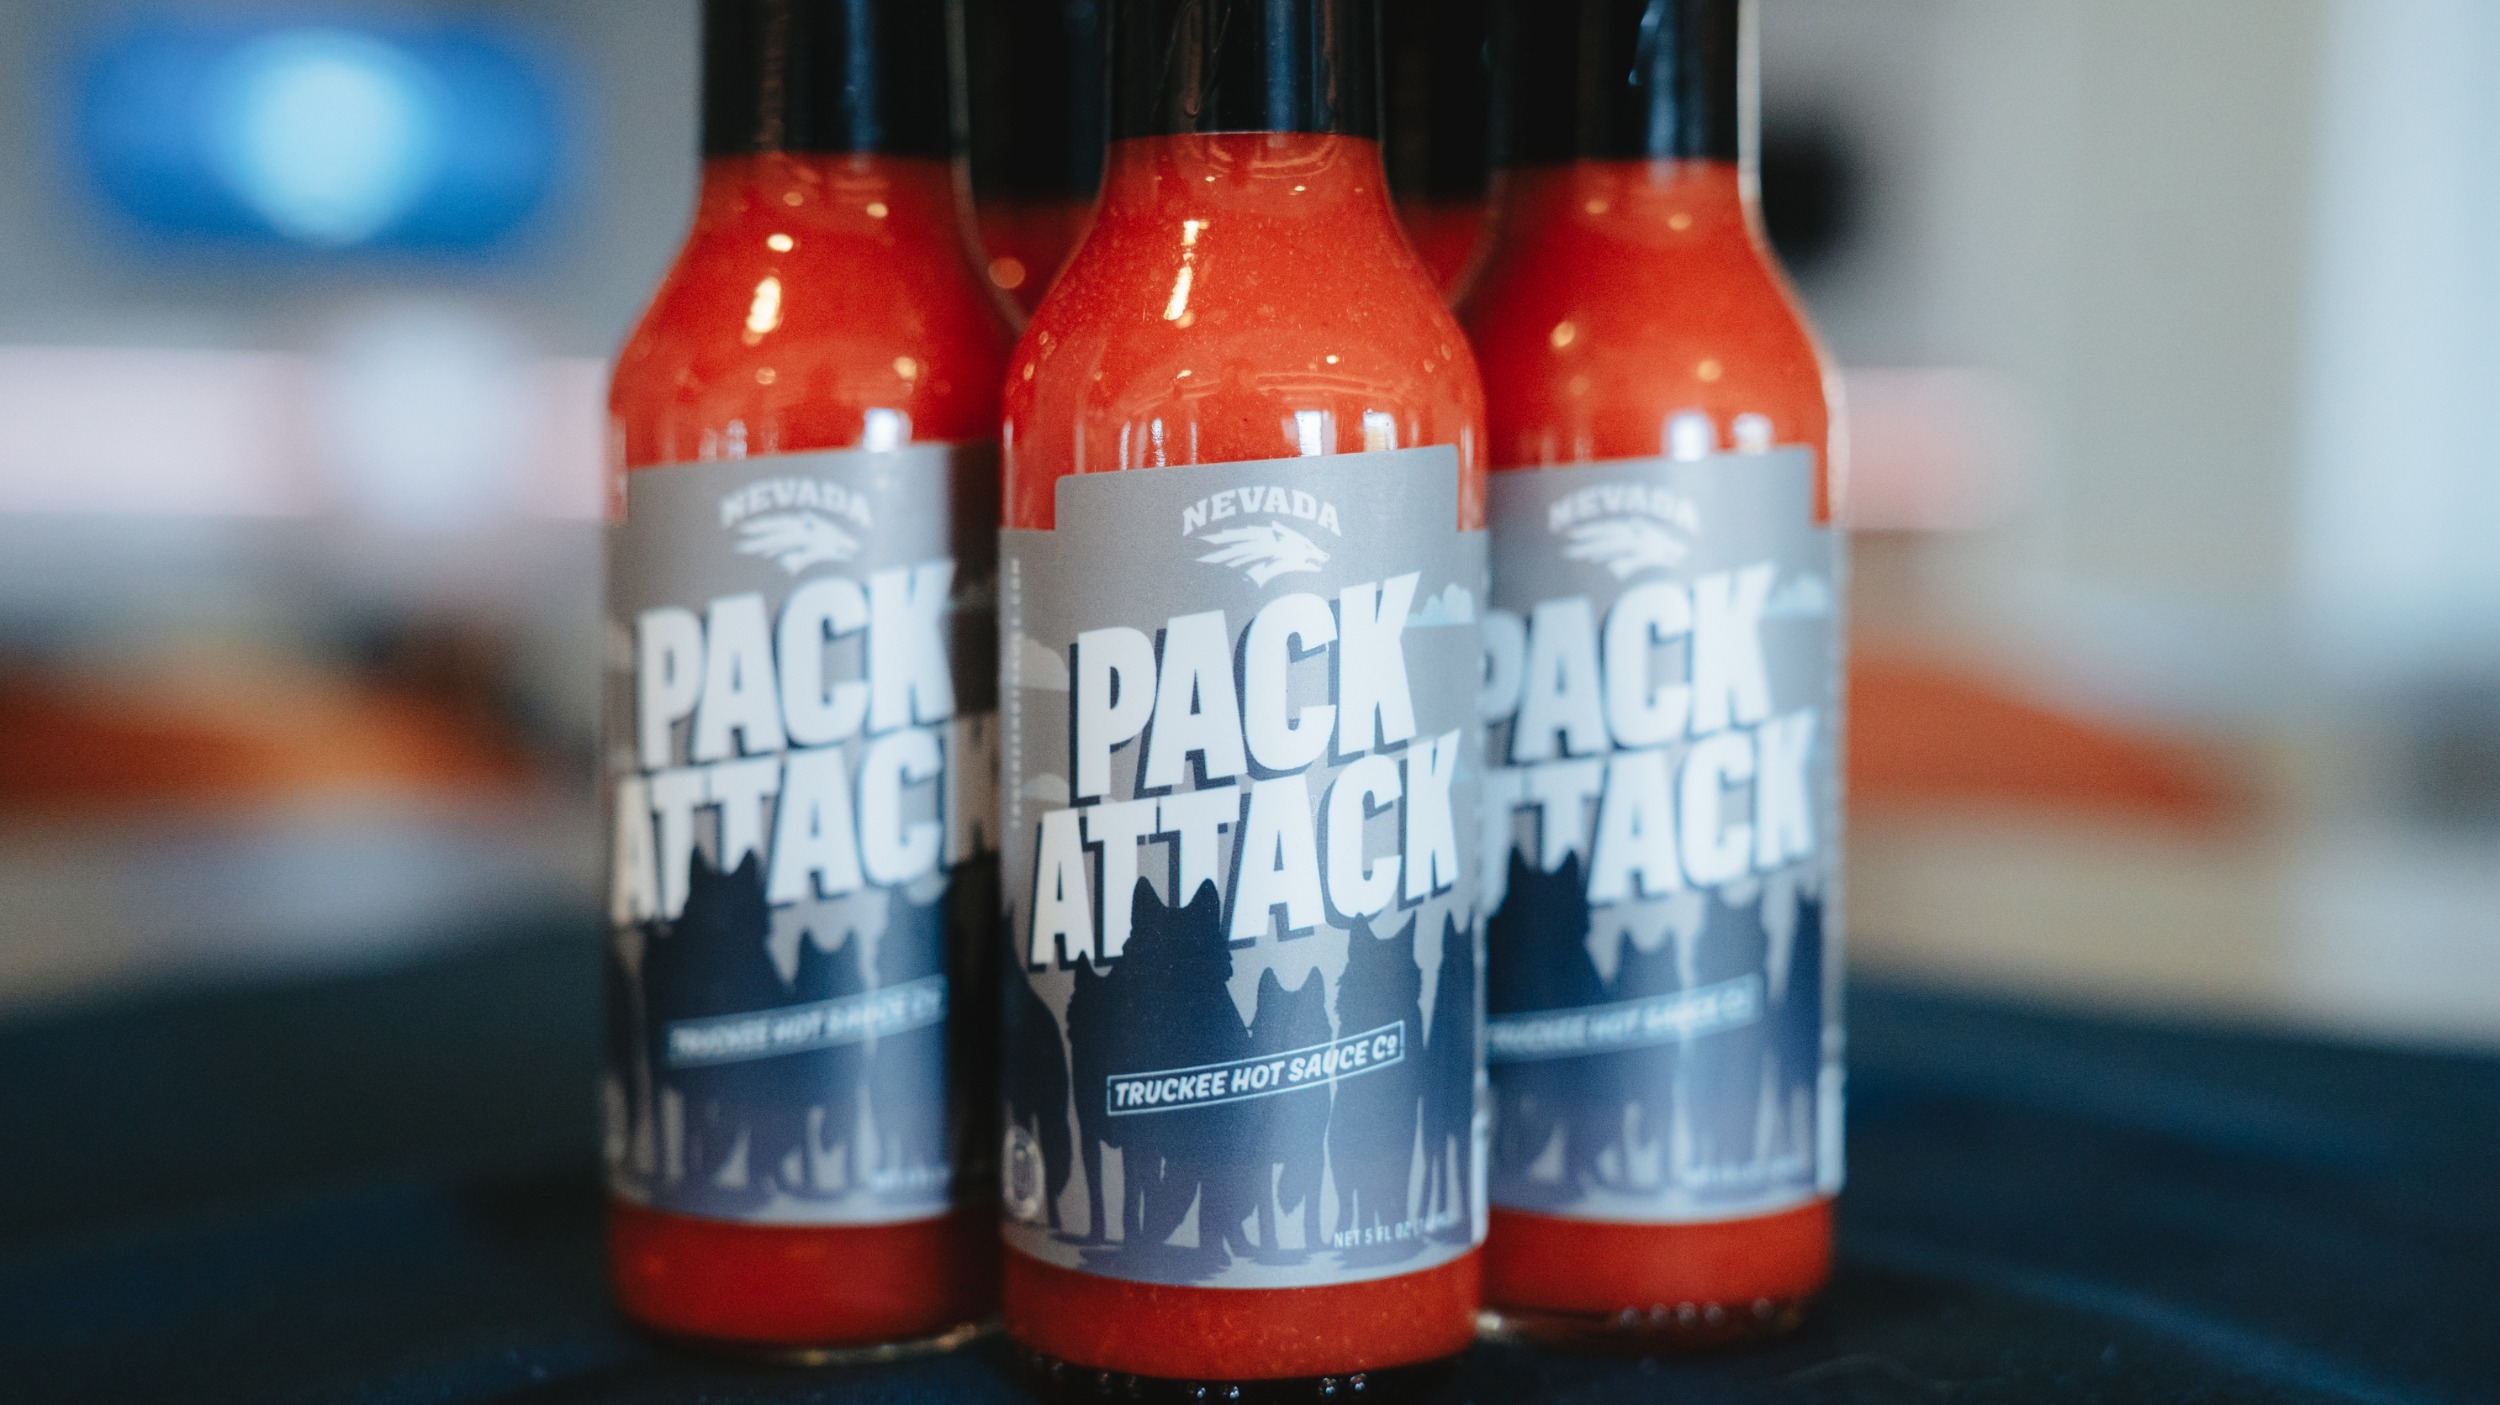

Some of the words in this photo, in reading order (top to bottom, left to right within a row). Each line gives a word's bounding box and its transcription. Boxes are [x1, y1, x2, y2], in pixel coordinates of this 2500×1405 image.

[720, 476, 872, 531] NEVADA
[1182, 485, 1342, 538] NEVADA
[639, 559, 957, 769] PACK
[1076, 571, 1422, 799] PACK
[1031, 728, 1462, 965] ATTACK
[1114, 1071, 1229, 1107] TRUCKEE
[1230, 1060, 1286, 1093] HOT
[1287, 1040, 1370, 1083] SAUCE
[1333, 1228, 1361, 1249] NET
[1376, 1224, 1391, 1243] FL
